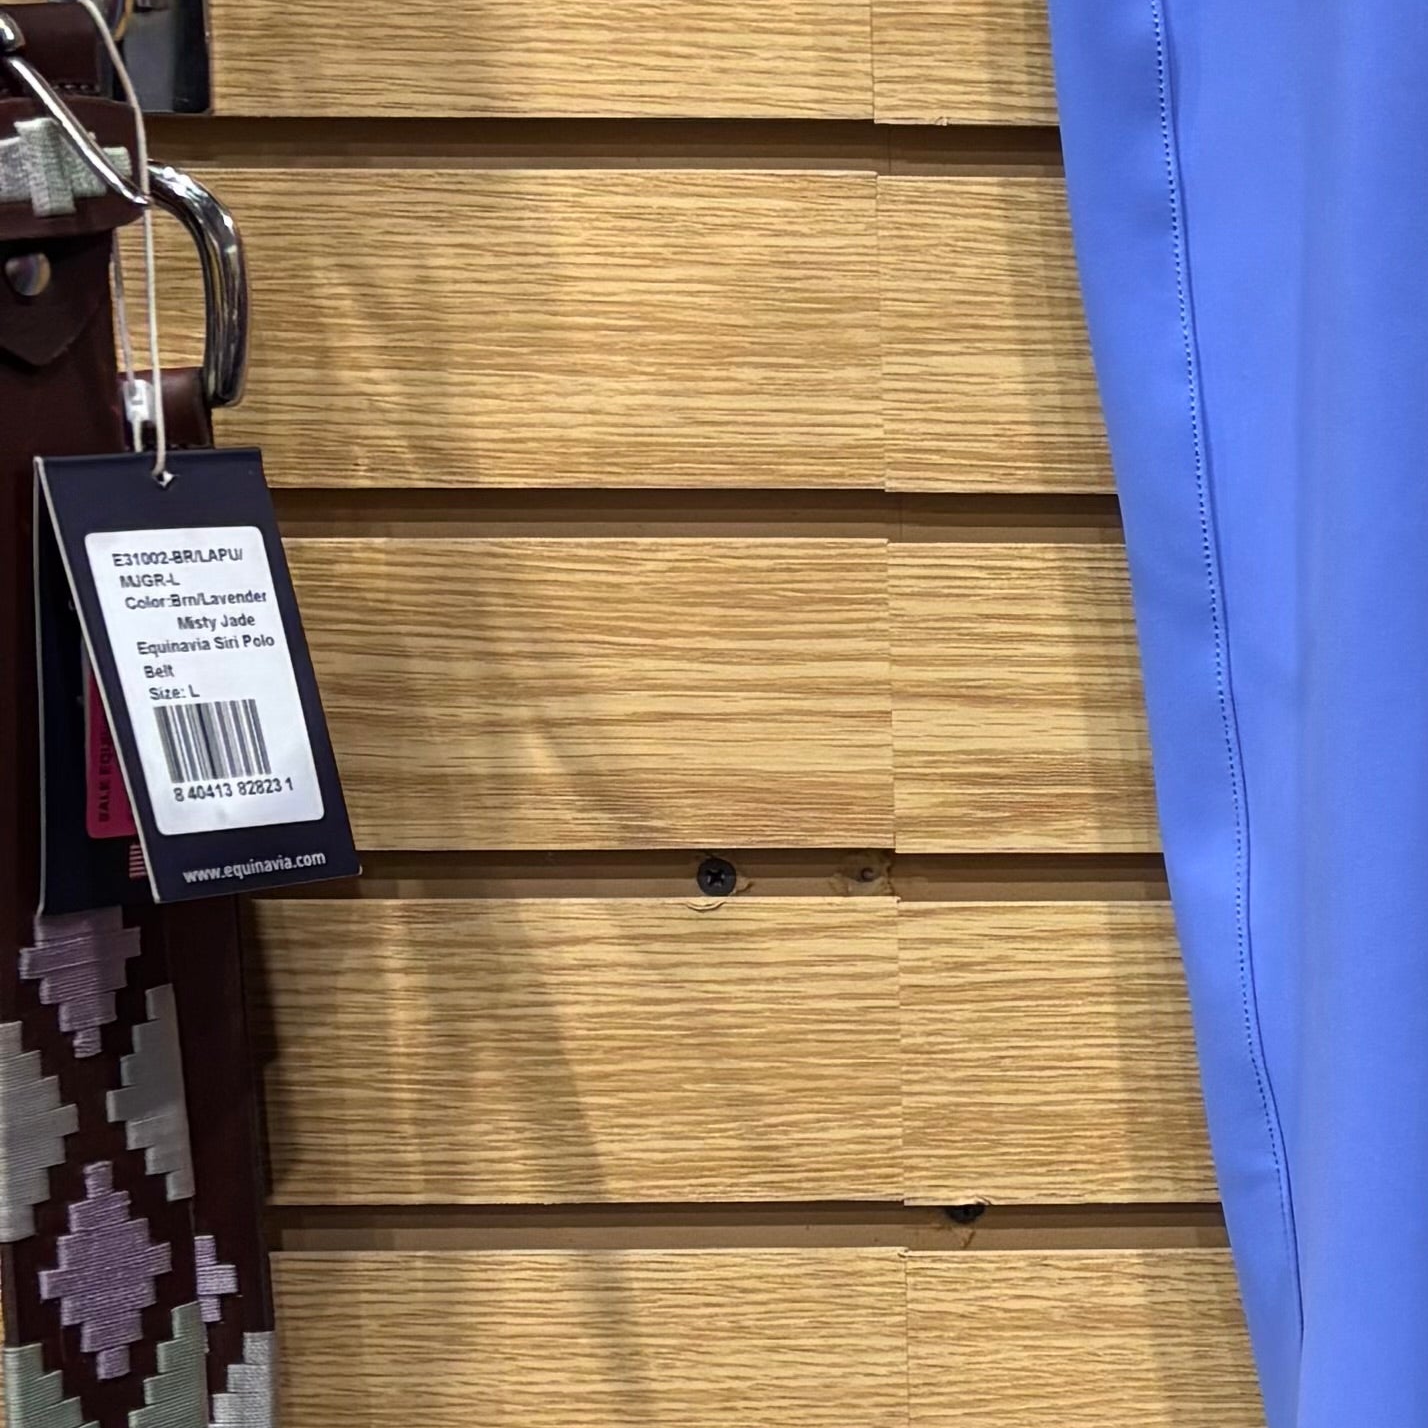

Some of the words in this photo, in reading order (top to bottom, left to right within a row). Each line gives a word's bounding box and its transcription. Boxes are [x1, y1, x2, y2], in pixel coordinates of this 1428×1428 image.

[177, 616, 217, 632] Misty
[220, 613, 256, 628] Jade
[136, 637, 212, 658] Equinavia
[213, 636, 240, 650] Siri
[242, 634, 275, 648] Polo
[143, 664, 175, 679] Belt
[149, 686, 187, 701] Size:
[188, 684, 201, 698] L
[173, 787, 185, 802] 8
[285, 777, 294, 791] 1
[183, 852, 327, 884] www.equinavia.com
